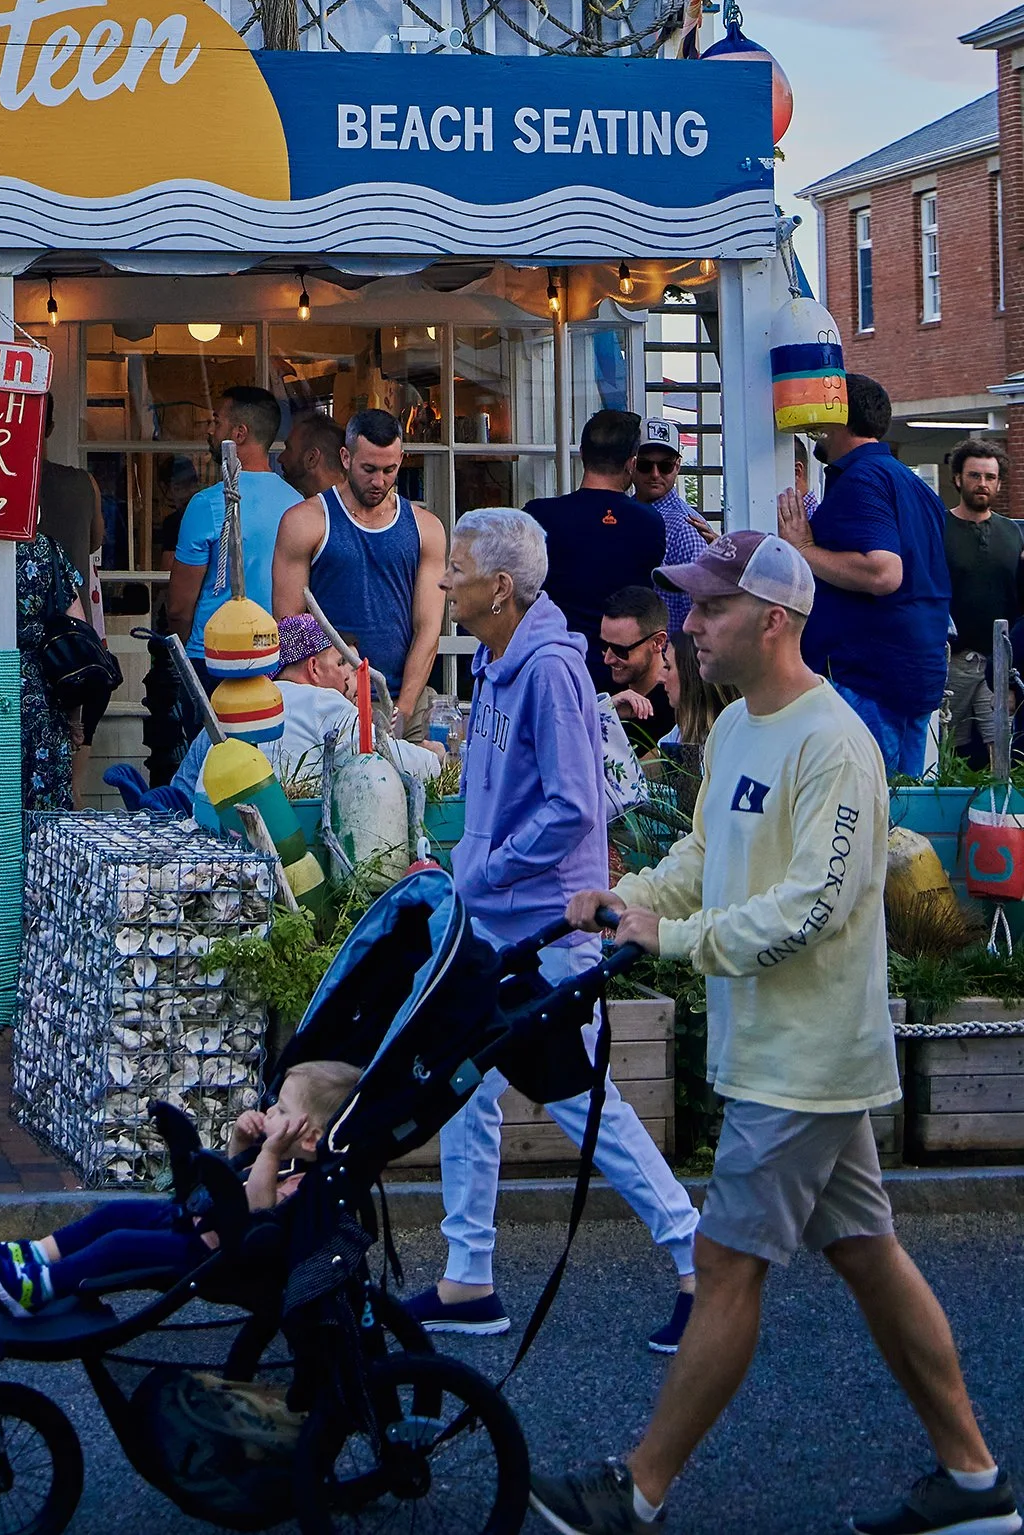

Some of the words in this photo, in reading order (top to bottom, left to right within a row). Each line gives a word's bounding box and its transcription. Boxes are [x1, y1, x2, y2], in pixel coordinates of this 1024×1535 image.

[337, 104, 494, 152] BEACH
[512, 107, 708, 157] SEATING
[824, 804, 860, 896] BLOCK
[756, 897, 835, 967] ISLAND
